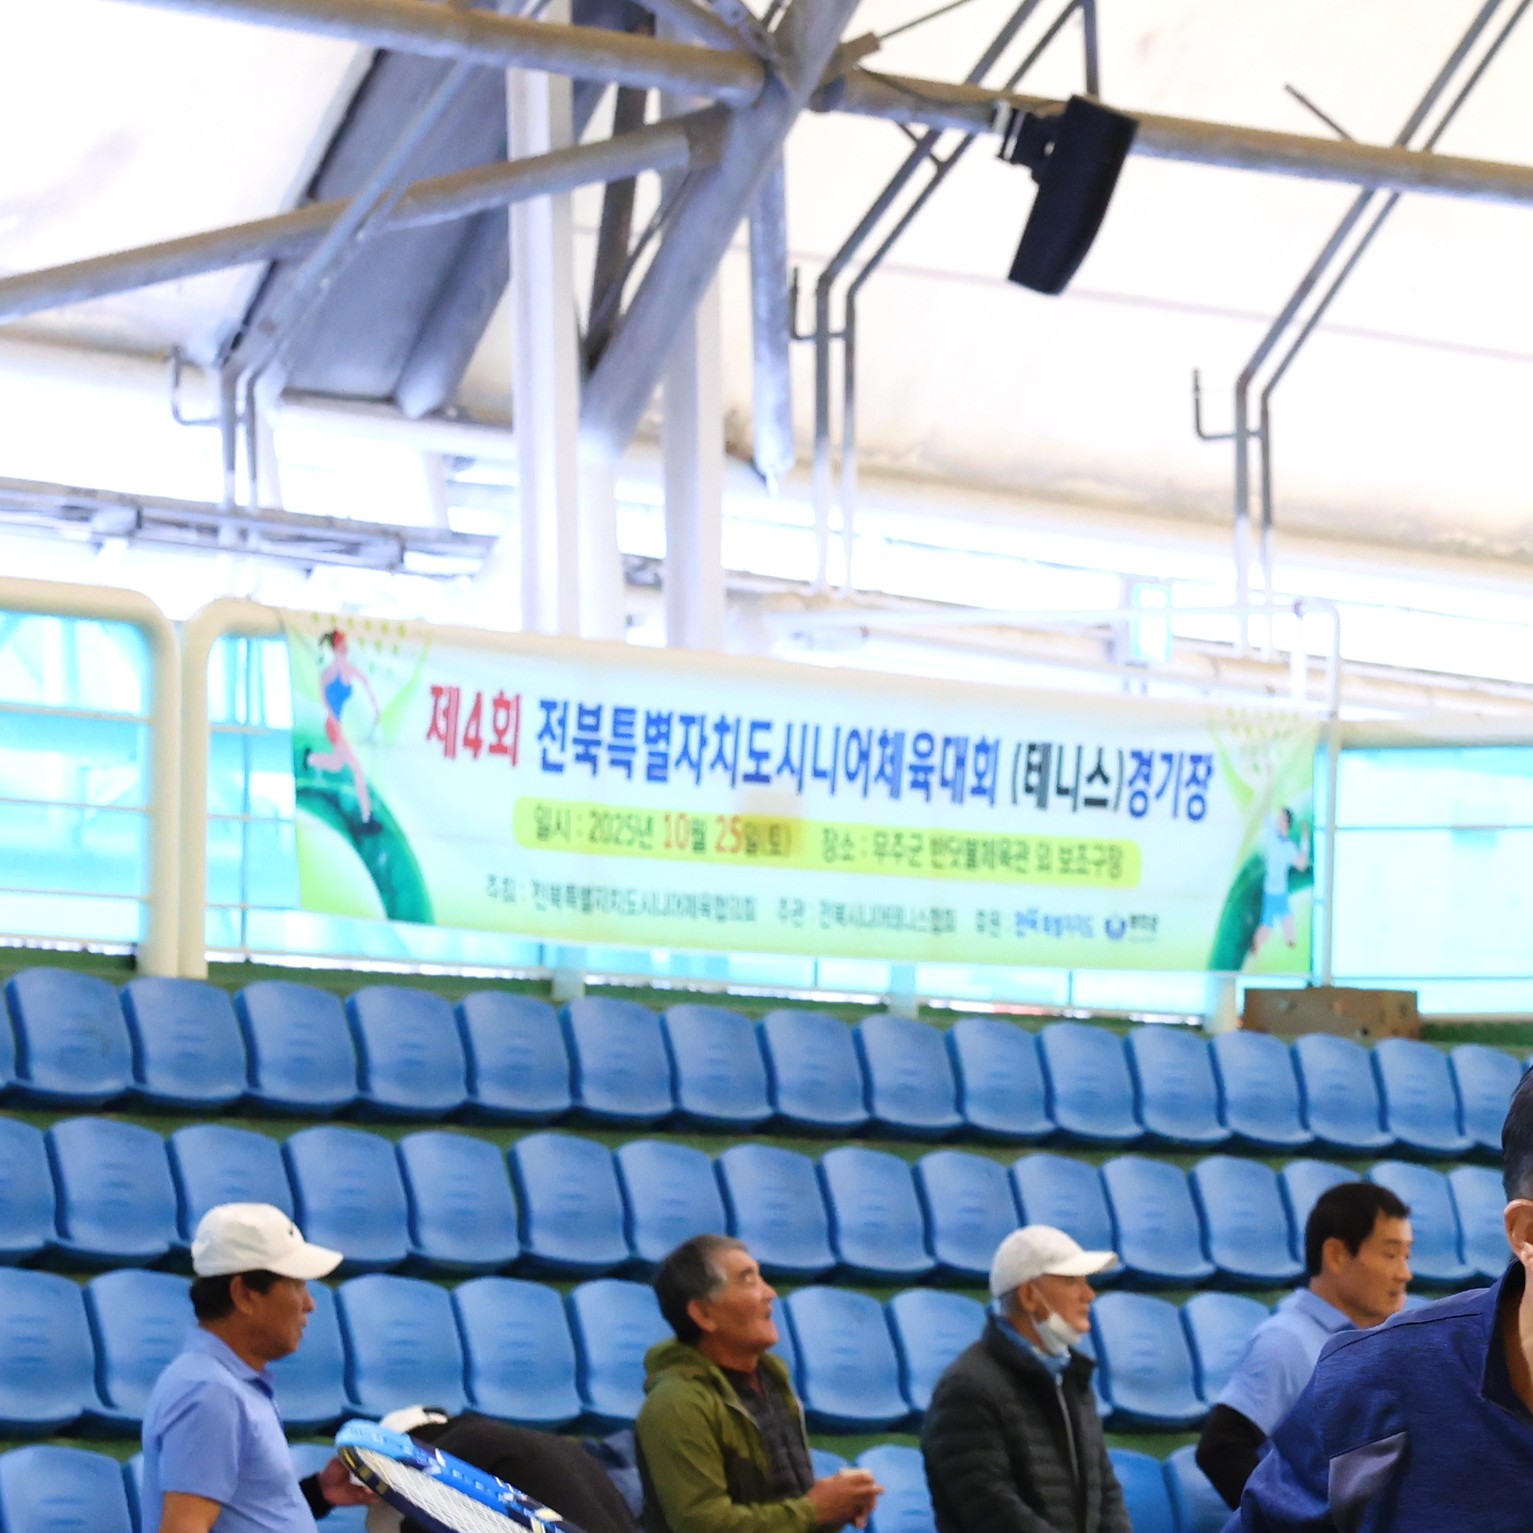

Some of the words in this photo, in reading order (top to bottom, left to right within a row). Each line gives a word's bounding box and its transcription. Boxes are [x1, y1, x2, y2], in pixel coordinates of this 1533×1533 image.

[426, 685, 521, 767] 제4회
[537, 699, 1000, 808] 전북특별자치도시니어체육대회
[1012, 741, 1214, 822] (테니스)경기장
[588, 811, 654, 850] 2025년
